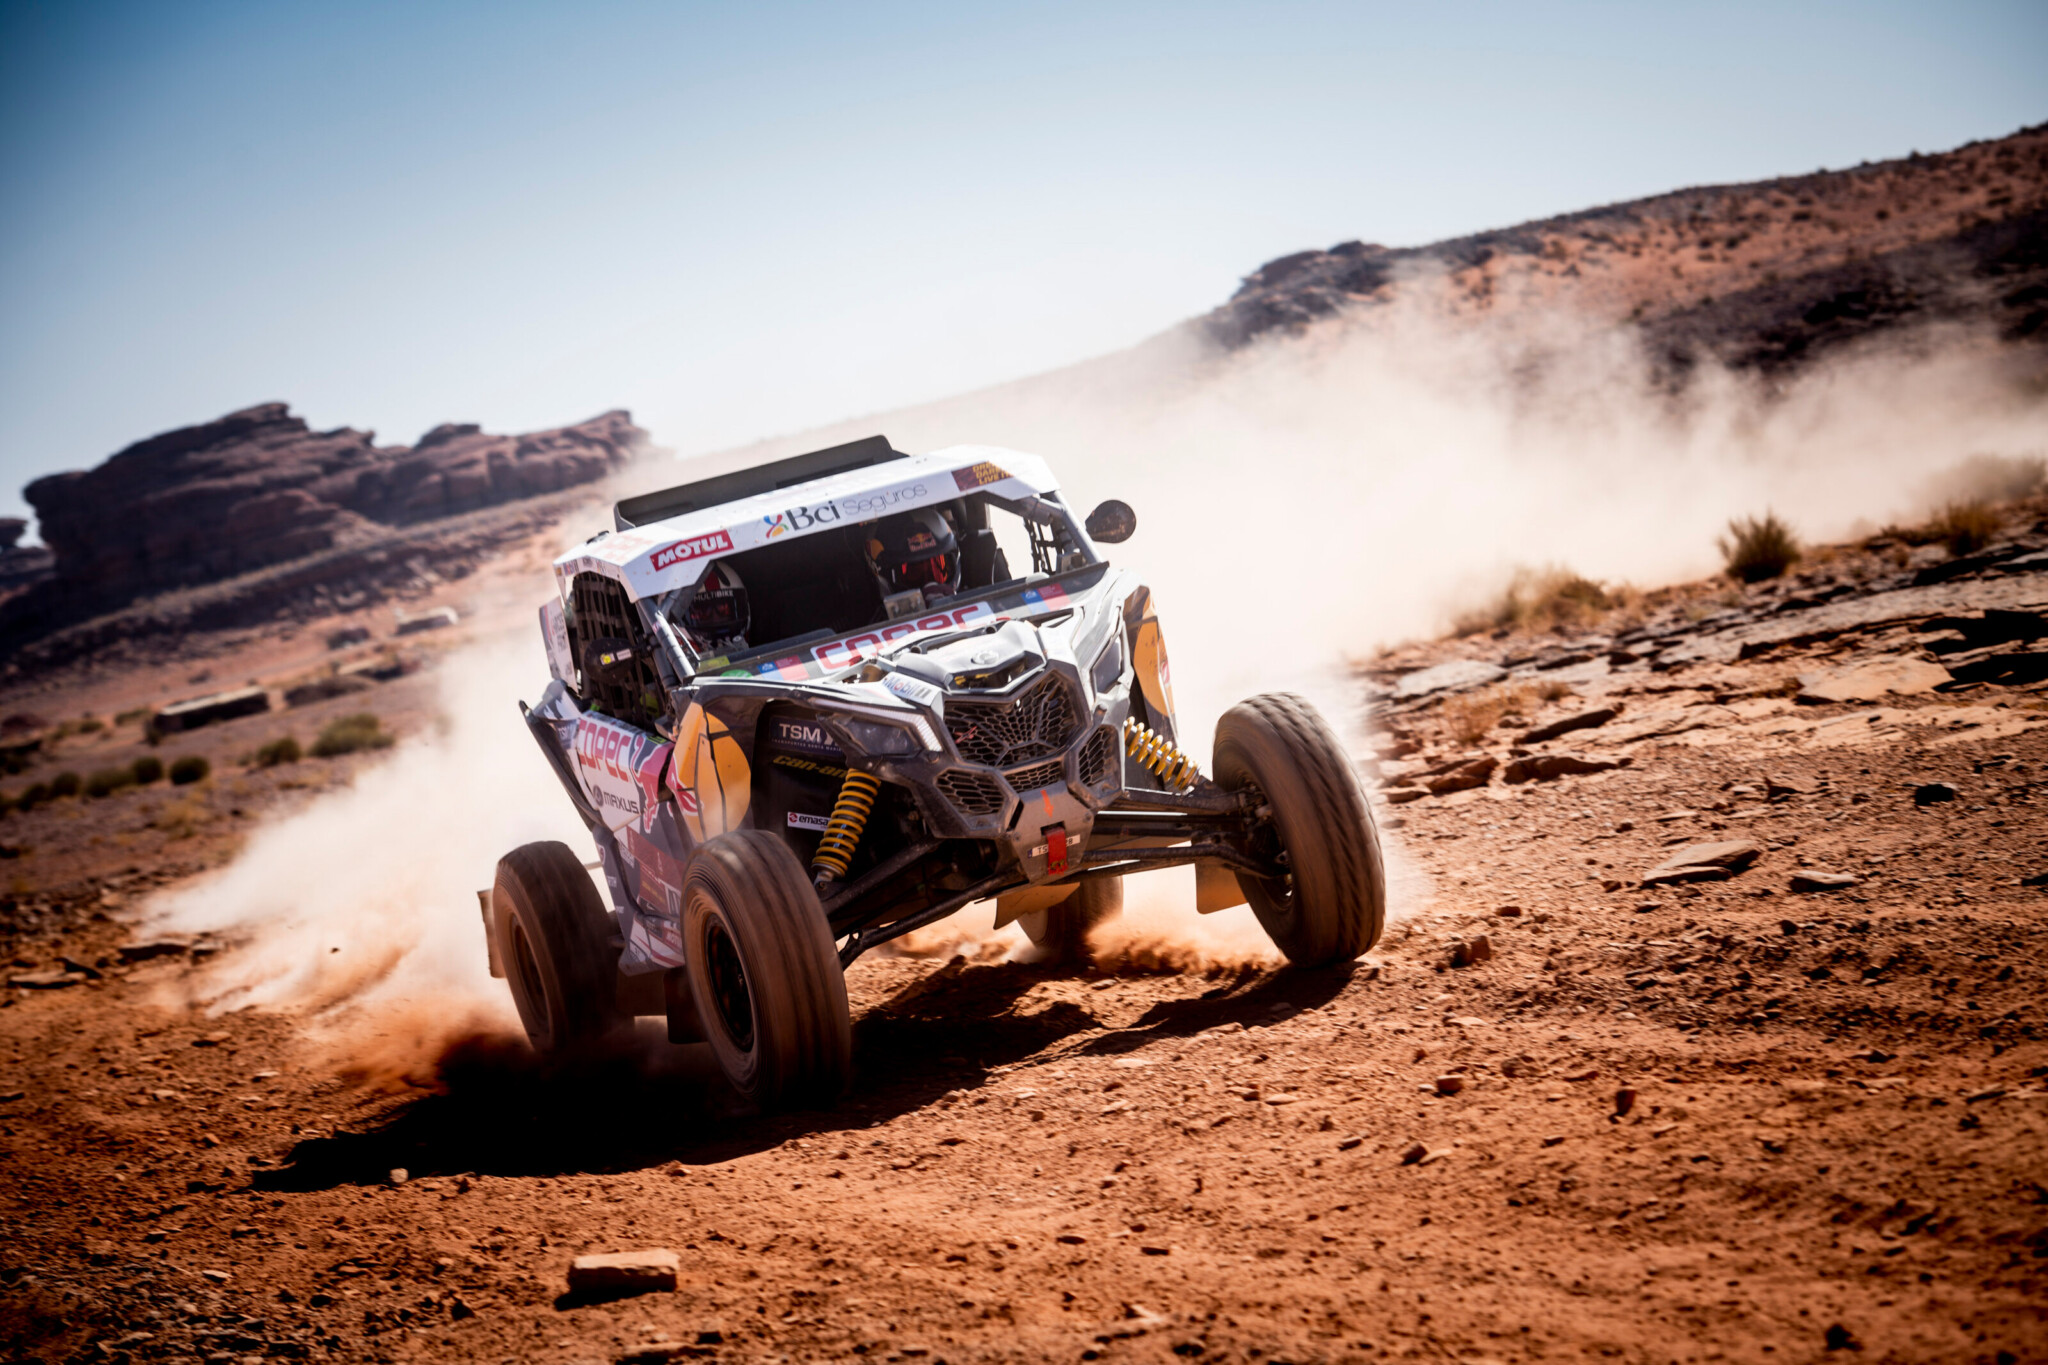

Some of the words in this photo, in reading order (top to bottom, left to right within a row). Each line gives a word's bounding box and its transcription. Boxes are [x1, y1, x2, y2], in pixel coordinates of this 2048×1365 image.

[786, 500, 841, 532] Bci
[843, 484, 928, 516] Seguros
[657, 534, 728, 568] MOTUL
[694, 589, 734, 602] MULTIBIKE
[779, 723, 821, 743] TSM
[602, 791, 641, 815] MAXUS
[798, 815, 829, 826] emasa
